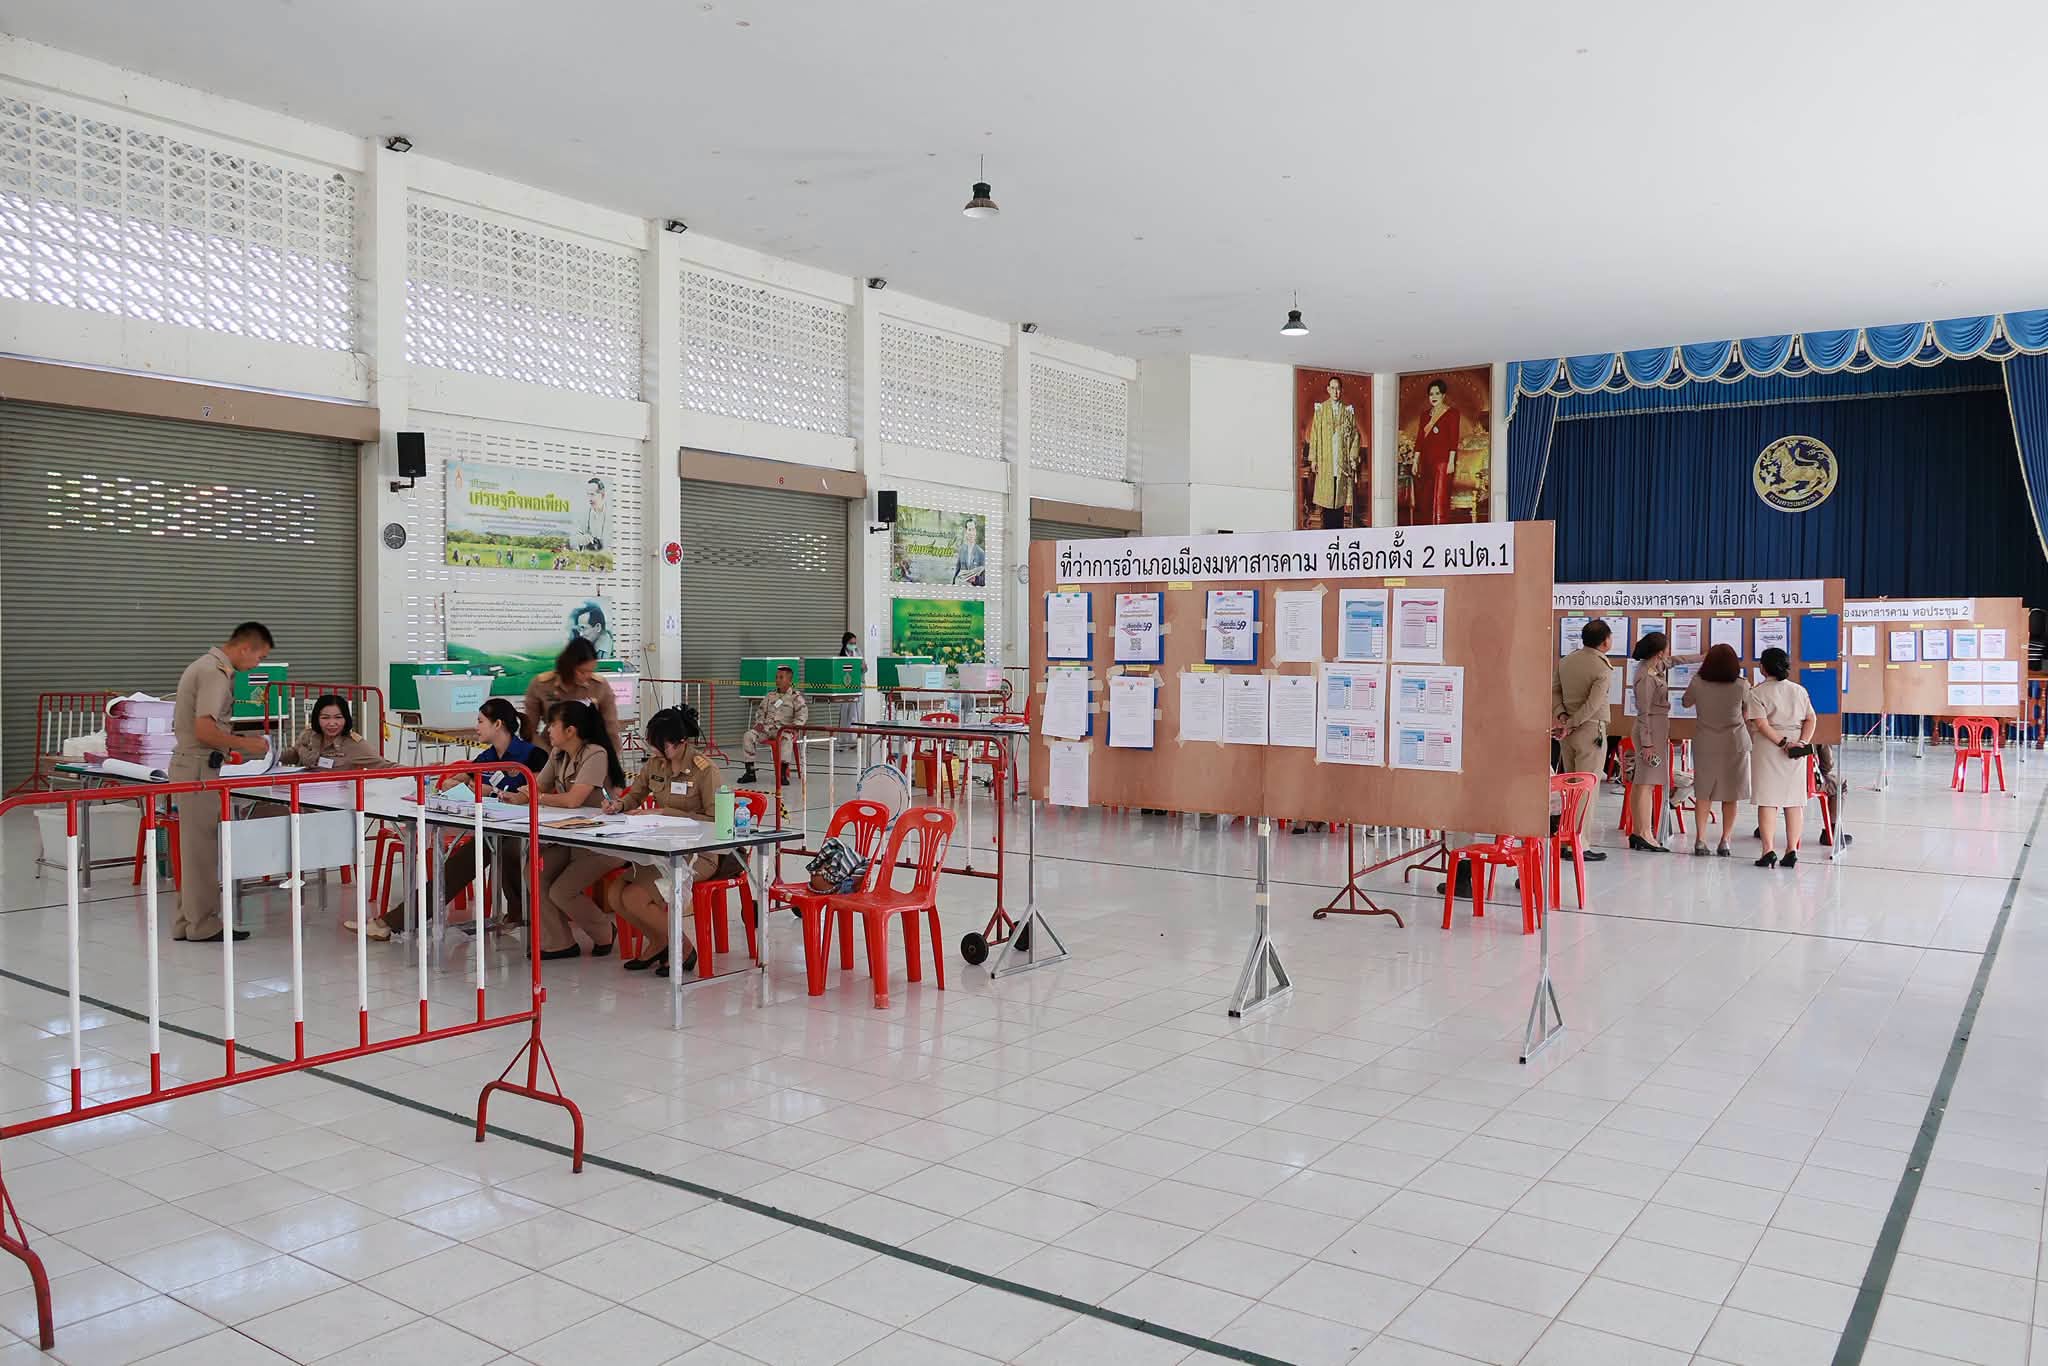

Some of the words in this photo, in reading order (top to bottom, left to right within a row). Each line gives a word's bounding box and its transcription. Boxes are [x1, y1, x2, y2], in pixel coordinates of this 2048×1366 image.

[1060, 545, 1317, 577] ที่ว่าการอำเภอเมืองมหาสารคาม
[1326, 530, 1413, 571] ที่เลือกตั้ง
[1422, 545, 1435, 568] 2
[1444, 540, 1509, 568] ผปต.1
[1710, 583, 1763, 606] ที่เลือกตั้ง
[1769, 591, 1775, 604] 1
[1781, 591, 1811, 604] นจ.1
[1962, 606, 1969, 616] 2
